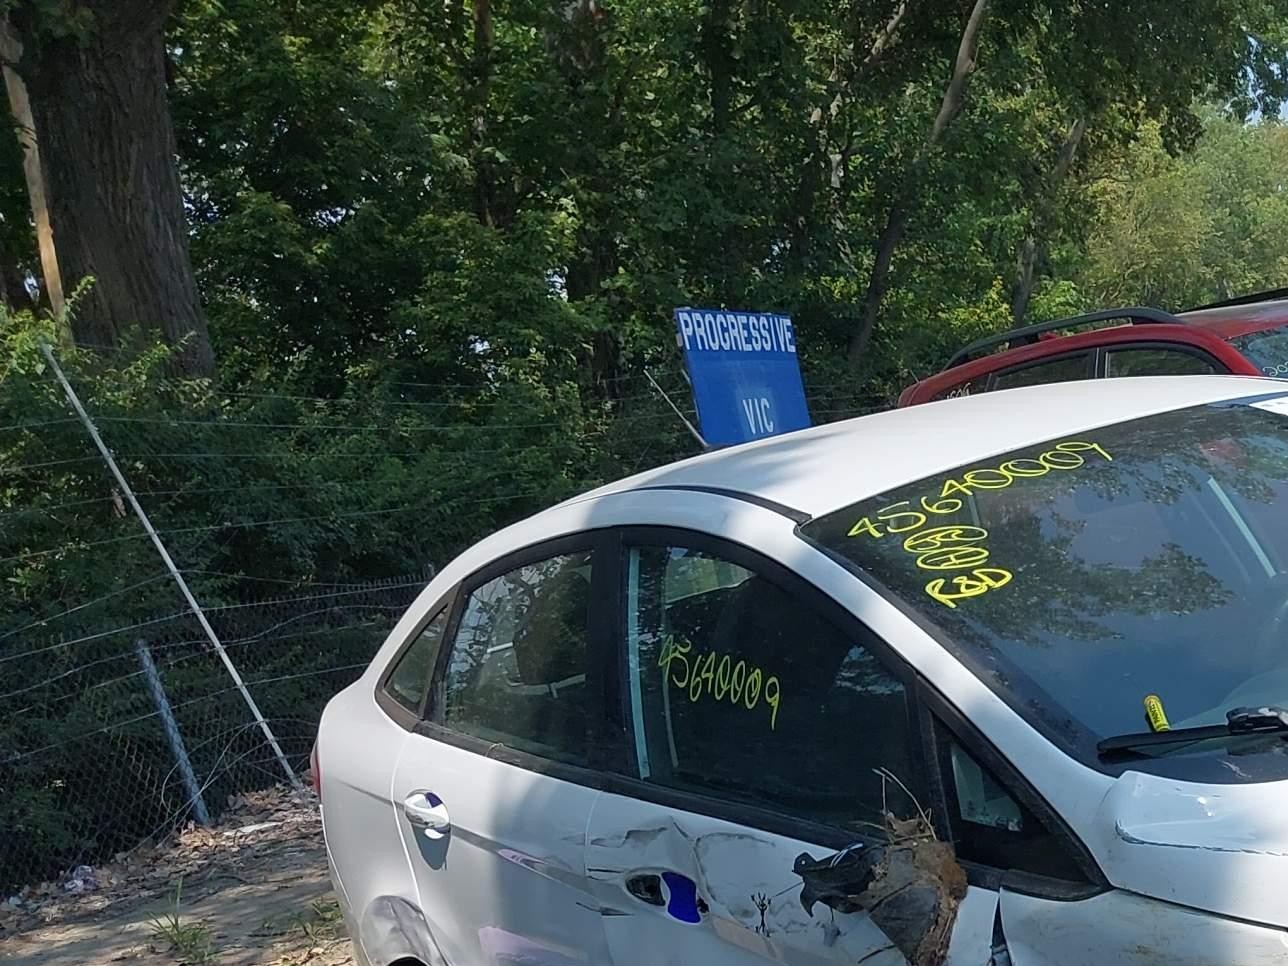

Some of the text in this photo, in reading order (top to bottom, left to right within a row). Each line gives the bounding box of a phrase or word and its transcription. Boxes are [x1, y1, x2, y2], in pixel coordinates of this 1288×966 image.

[678, 312, 796, 352] PROGRESSIVE
[743, 398, 774, 434] VIC
[847, 441, 1113, 537] 45640009
[658, 634, 780, 730] 45640009
